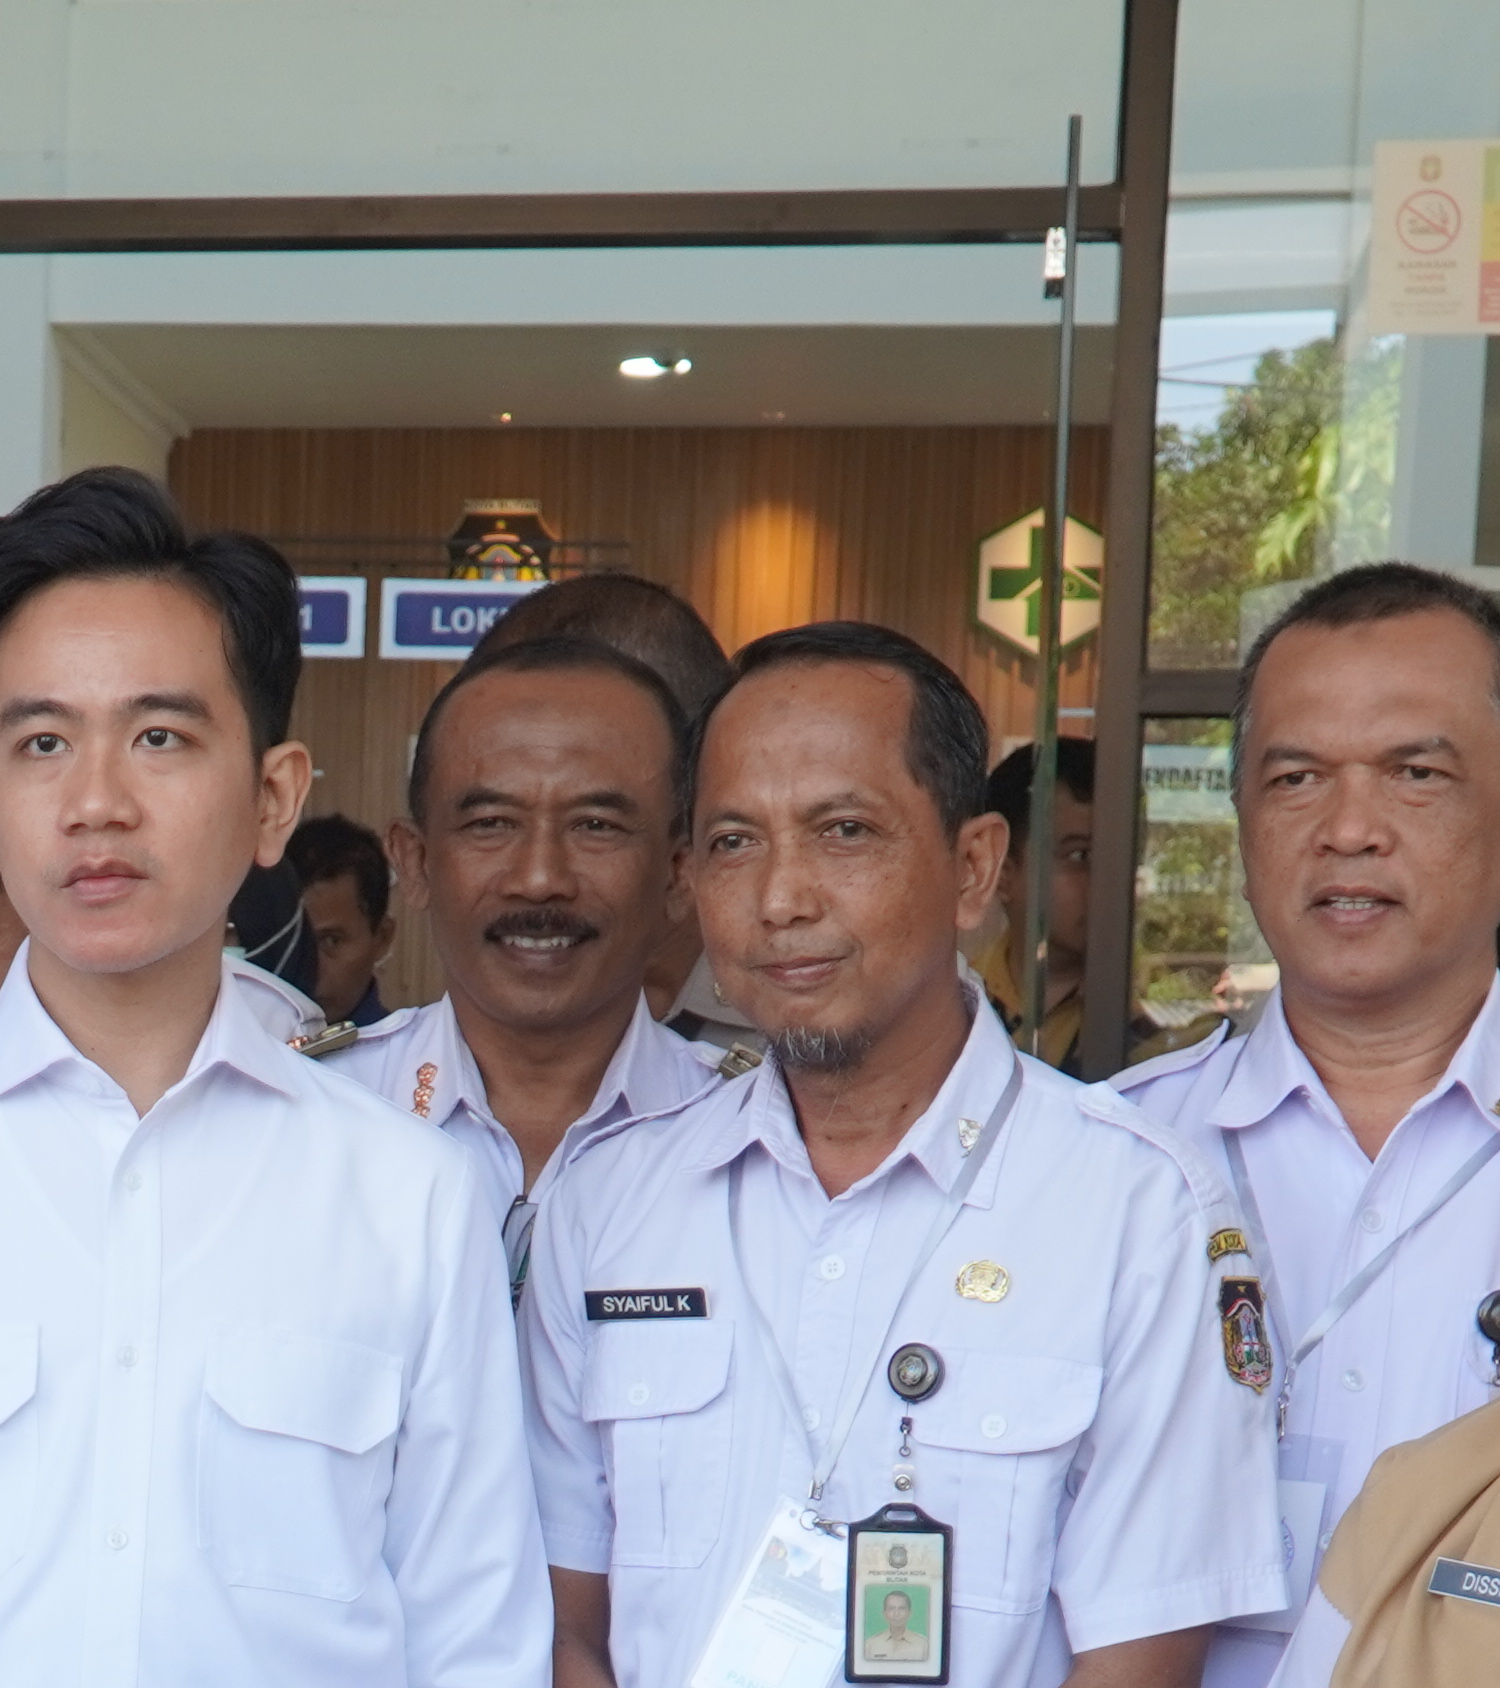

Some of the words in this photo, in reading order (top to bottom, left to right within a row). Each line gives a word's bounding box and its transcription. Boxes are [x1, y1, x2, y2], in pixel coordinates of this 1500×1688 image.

[431, 605, 508, 634] LOK
[603, 1295, 675, 1312] SYAIFUL
[677, 1294, 691, 1311] K
